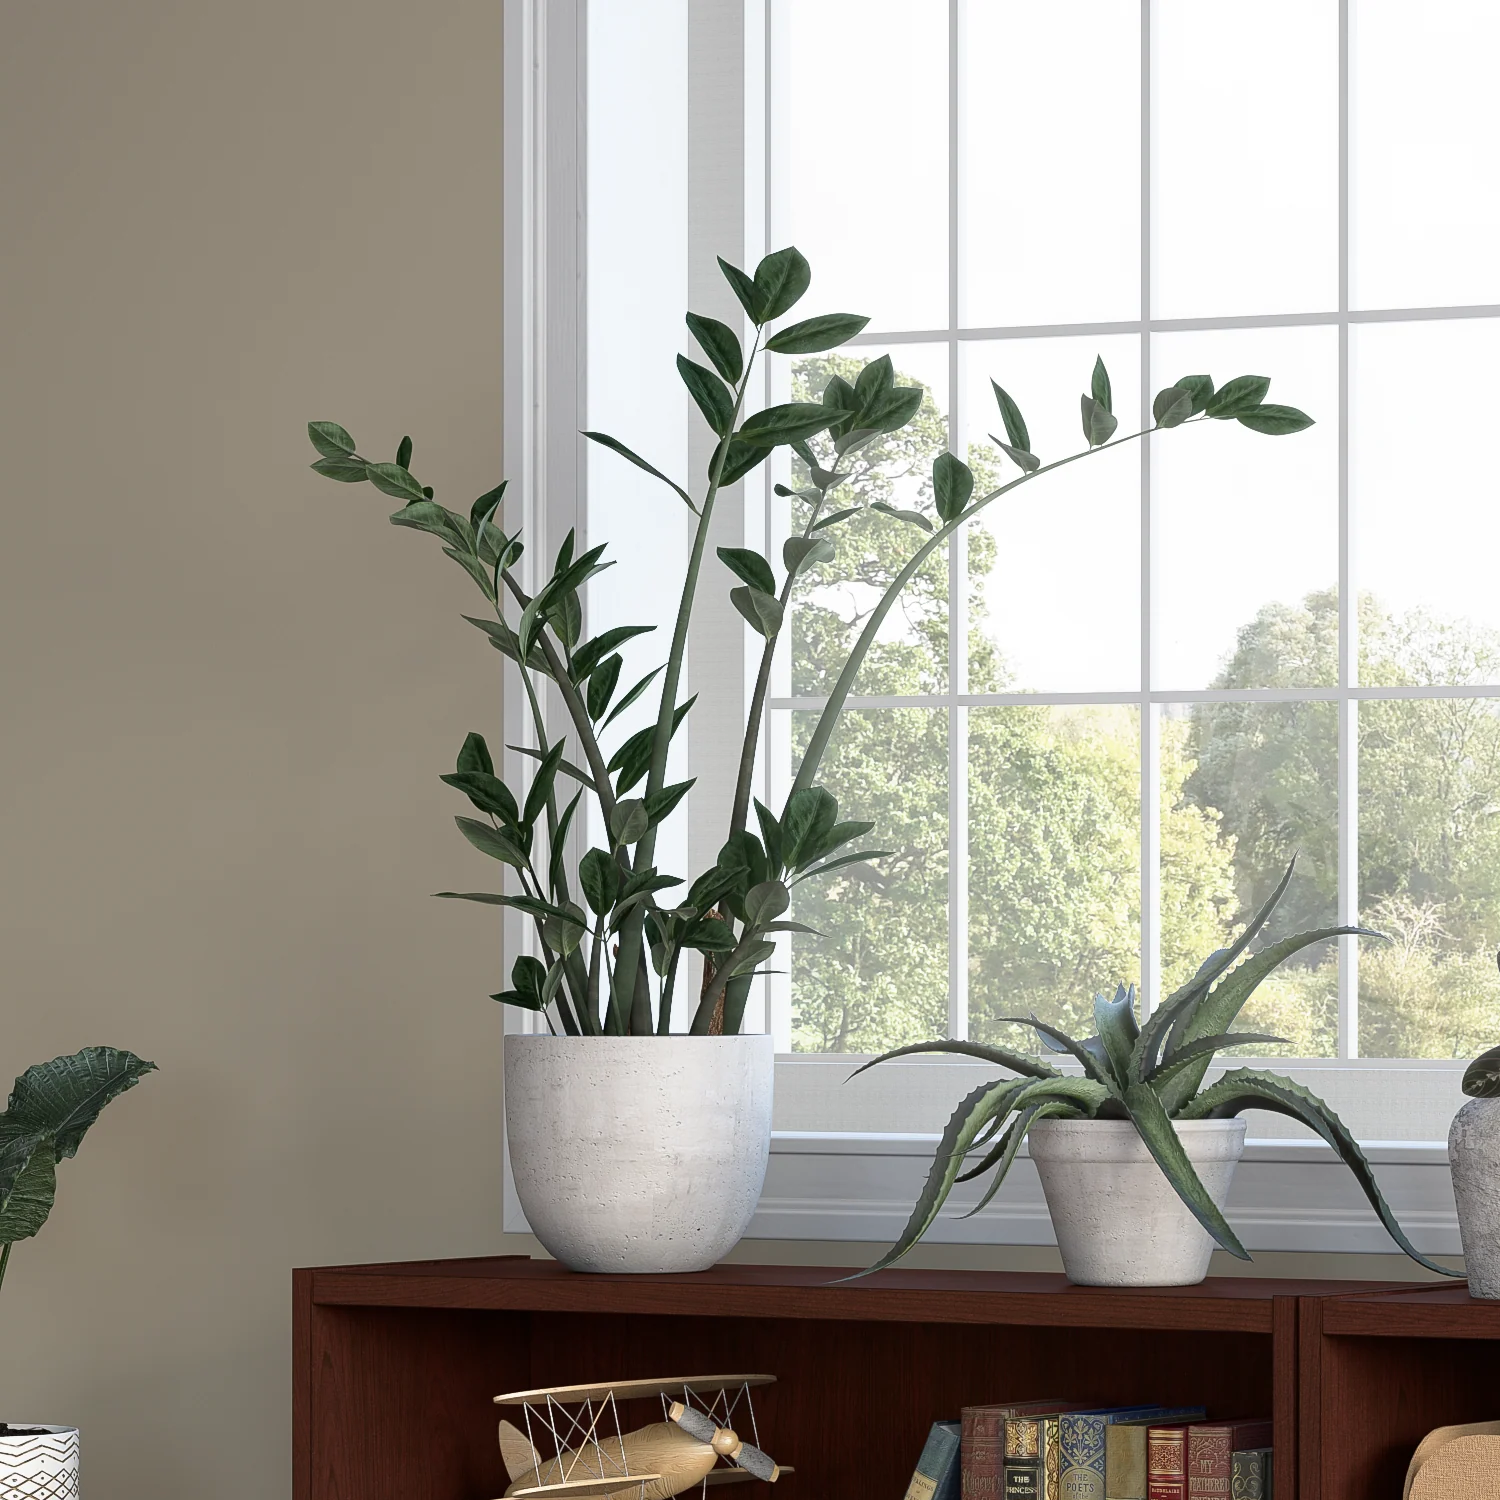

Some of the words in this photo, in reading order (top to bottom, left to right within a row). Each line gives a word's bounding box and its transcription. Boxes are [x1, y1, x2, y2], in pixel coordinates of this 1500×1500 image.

[1200, 1460, 1213, 1473] MY
[1066, 1483, 1094, 1492] POETS
[1190, 1478, 1229, 1492] FEATHERED
